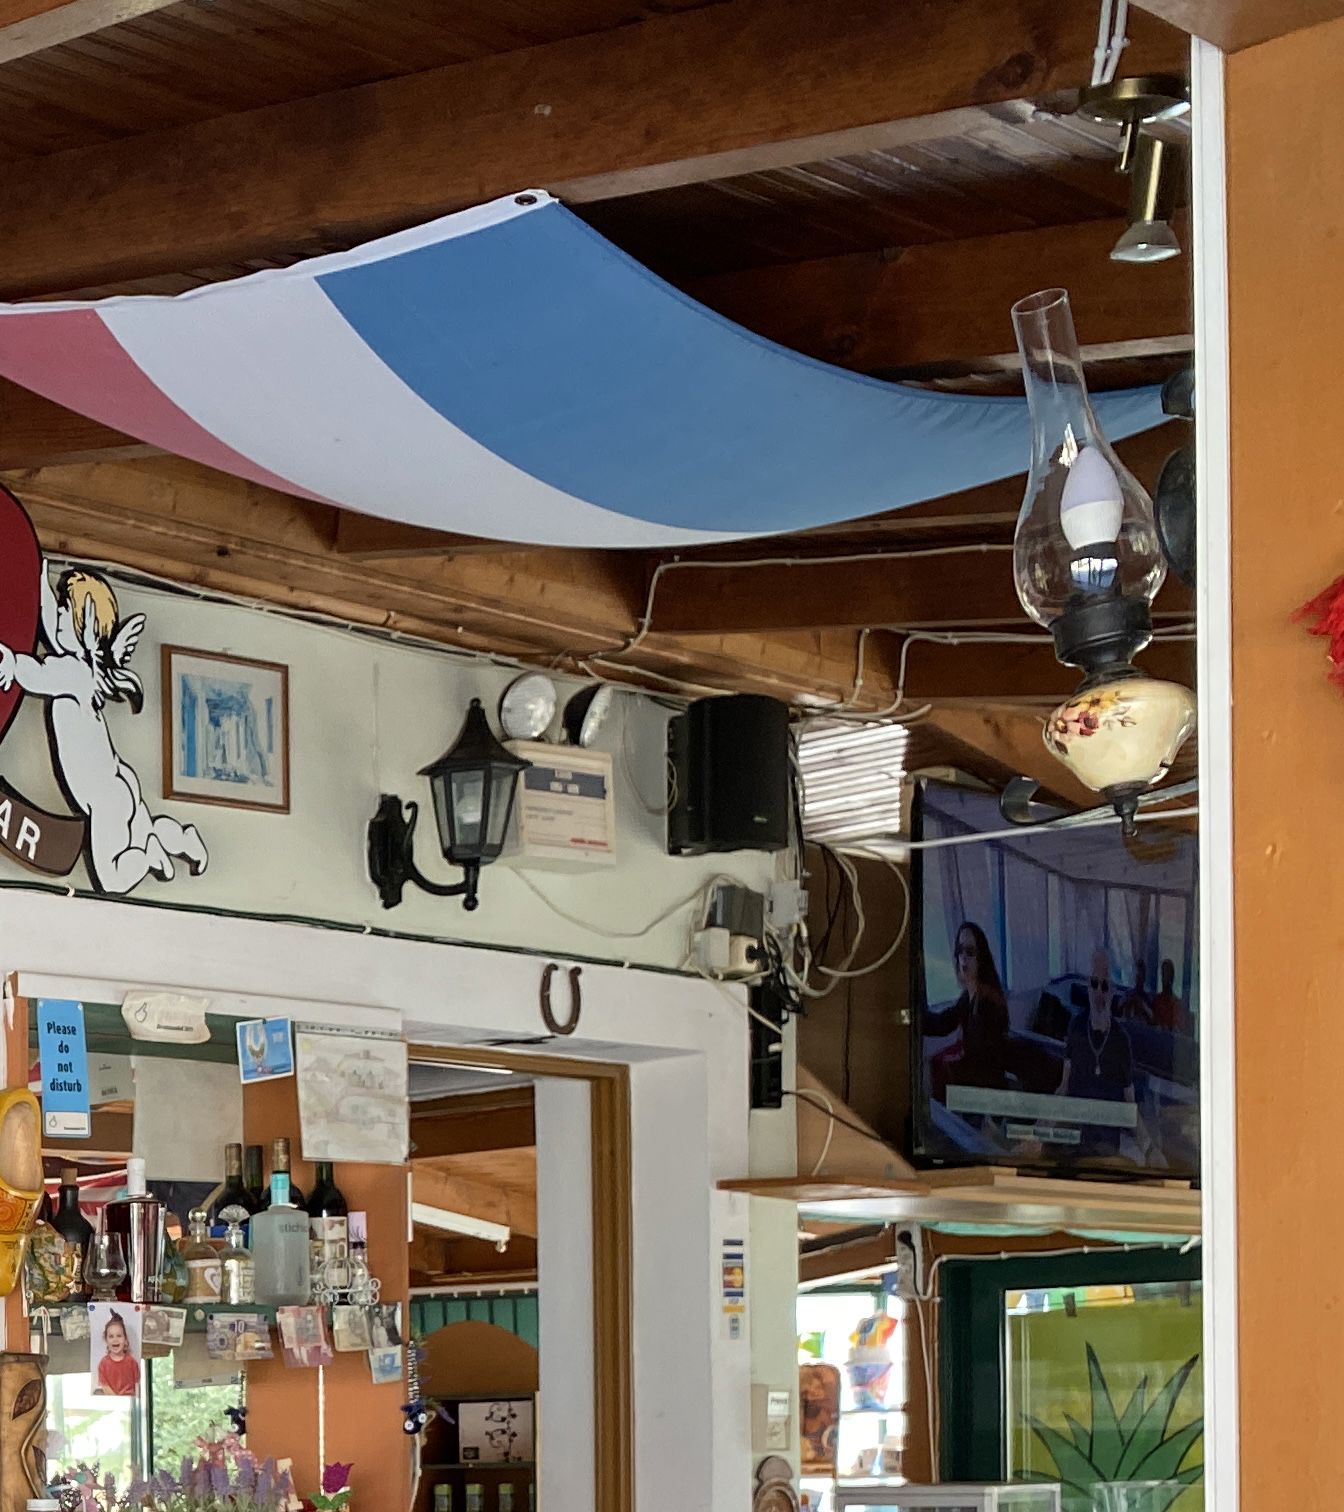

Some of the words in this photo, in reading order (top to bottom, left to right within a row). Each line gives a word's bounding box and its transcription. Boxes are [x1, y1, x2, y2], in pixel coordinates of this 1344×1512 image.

[46, 1022, 78, 1037] Please
[58, 1039, 71, 1055] do
[57, 1060, 73, 1074] not
[49, 1078, 83, 1093] disturb
[234, 1320, 245, 1333] 10
